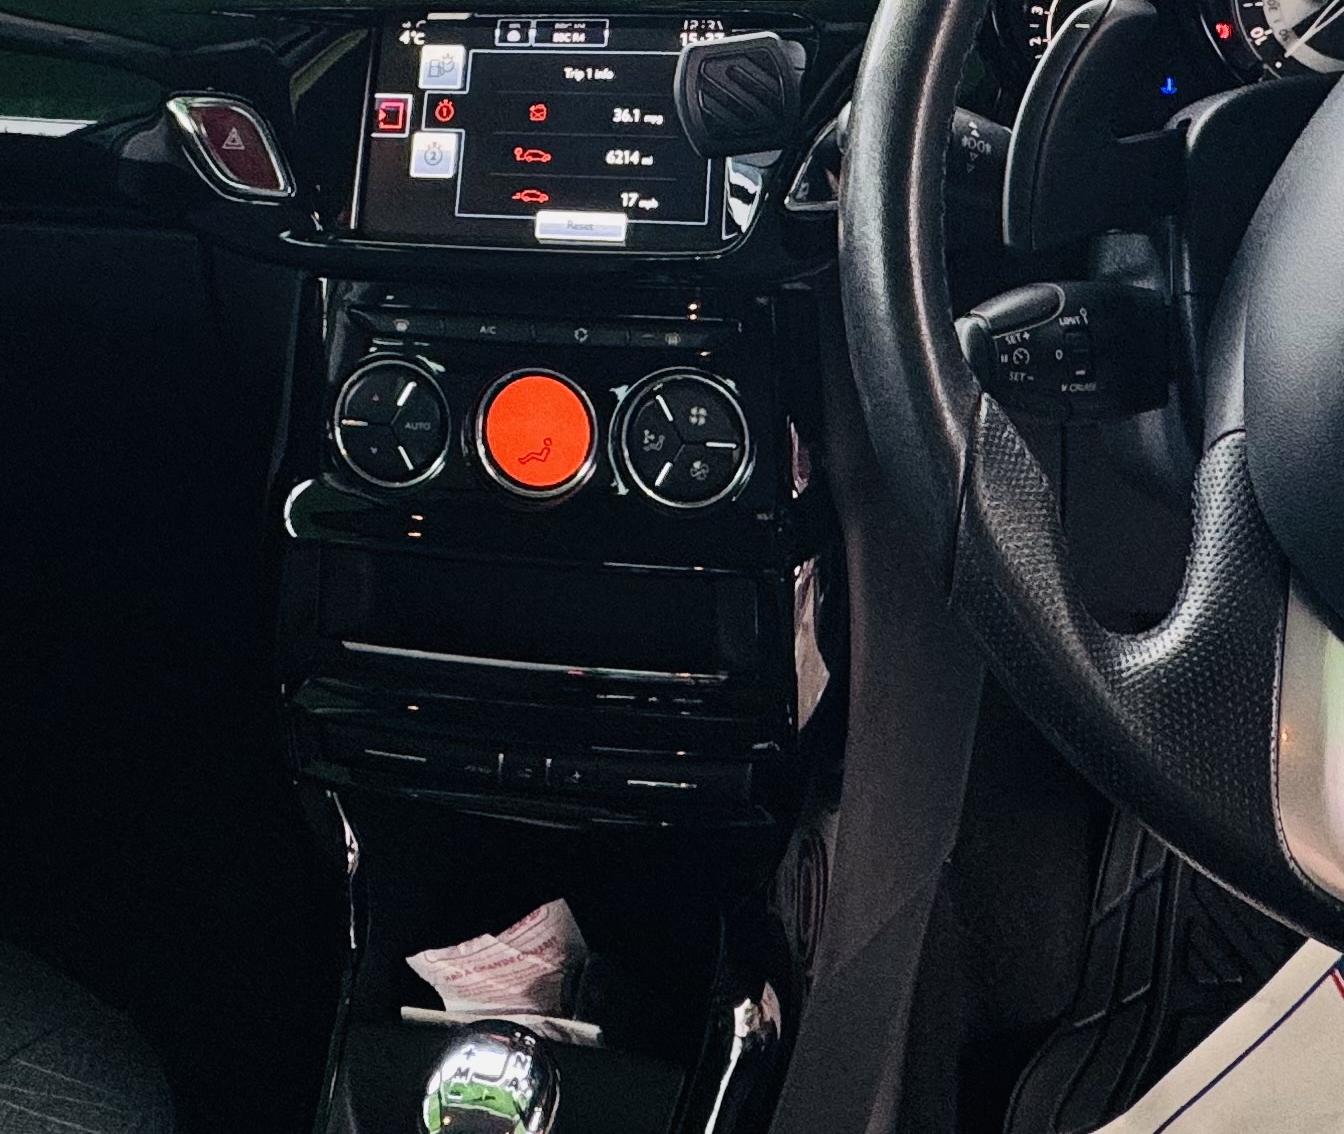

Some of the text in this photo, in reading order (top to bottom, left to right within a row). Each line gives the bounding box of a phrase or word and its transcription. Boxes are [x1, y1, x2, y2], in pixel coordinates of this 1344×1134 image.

[1031, 6, 1043, 15] 3
[1029, 36, 1041, 46] 2
[1250, 26, 1265, 46] 10
[564, 67, 614, 81] Trip 1 info
[612, 108, 641, 123] 36.1
[605, 150, 640, 165] 6214
[620, 192, 639, 208] 17
[567, 220, 594, 231] Reset
[480, 325, 496, 334] A/C
[405, 422, 431, 431] AUTO
[516, 1054, 529, 1067] N
[452, 1067, 470, 1080] M
